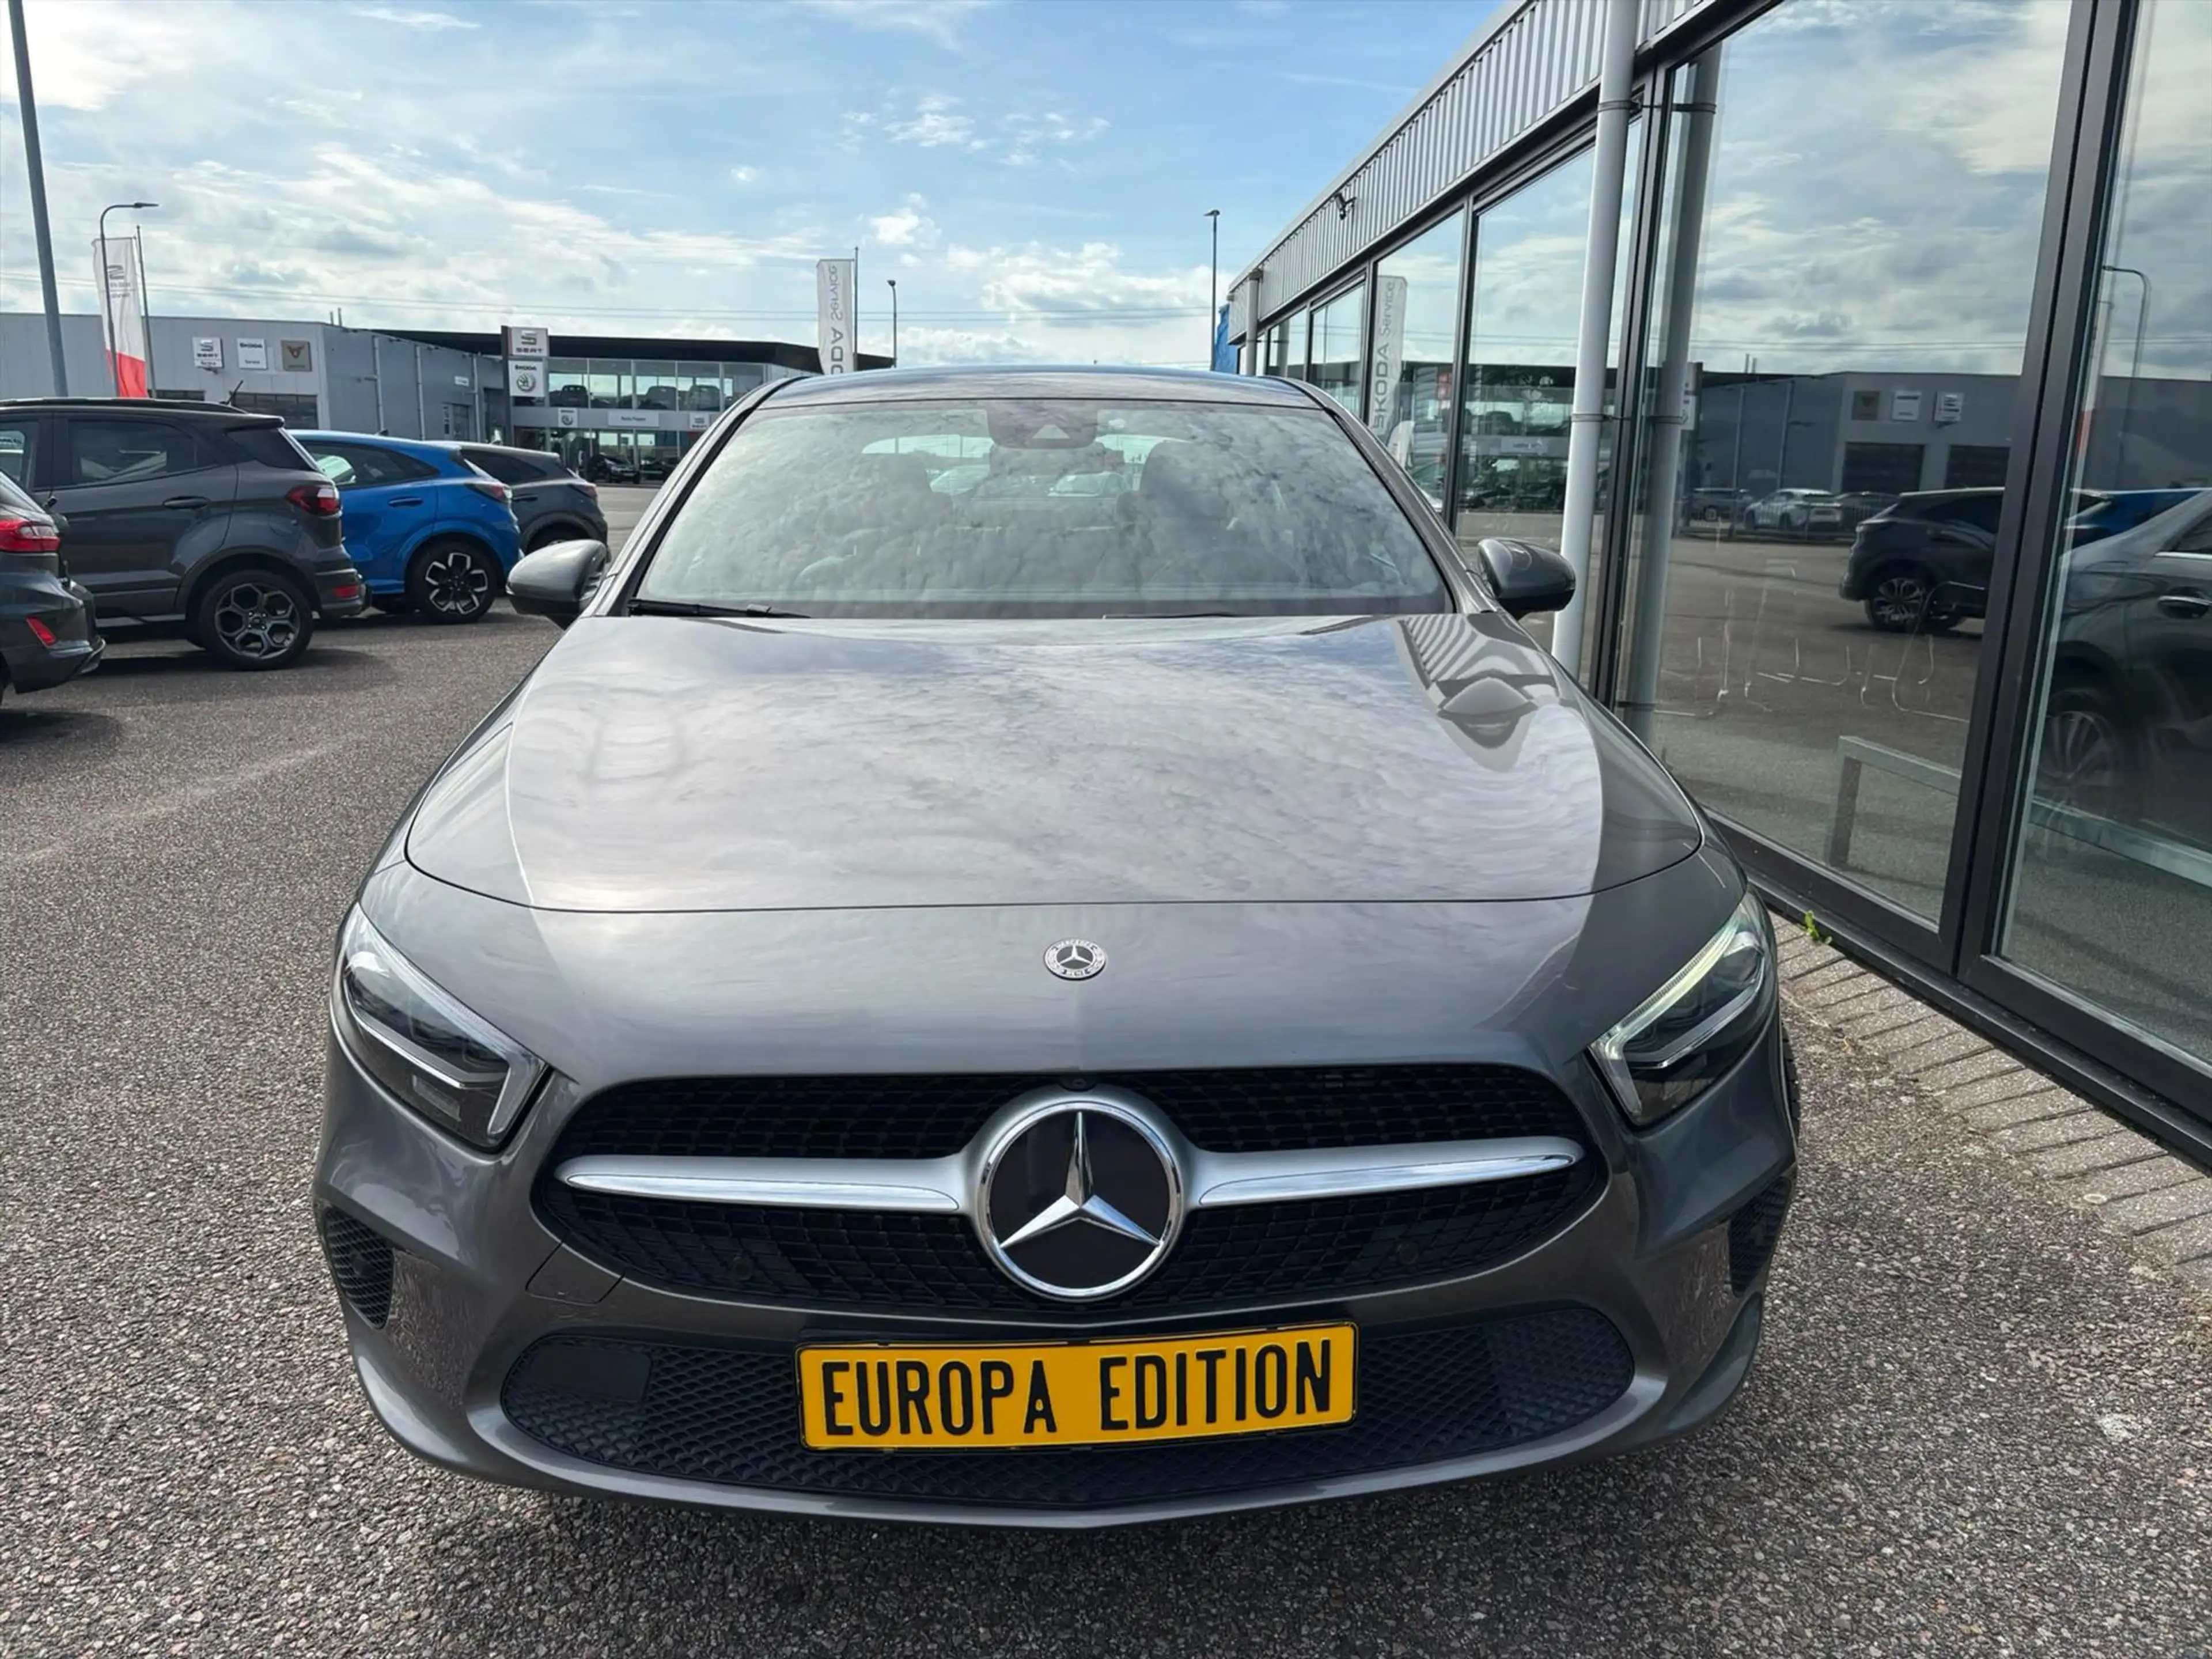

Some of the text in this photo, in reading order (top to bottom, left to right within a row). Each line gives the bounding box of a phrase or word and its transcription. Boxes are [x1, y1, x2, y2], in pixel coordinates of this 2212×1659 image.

[1379, 281, 1395, 337] Service
[821, 1339, 1331, 1436] EUROPA EDITION
